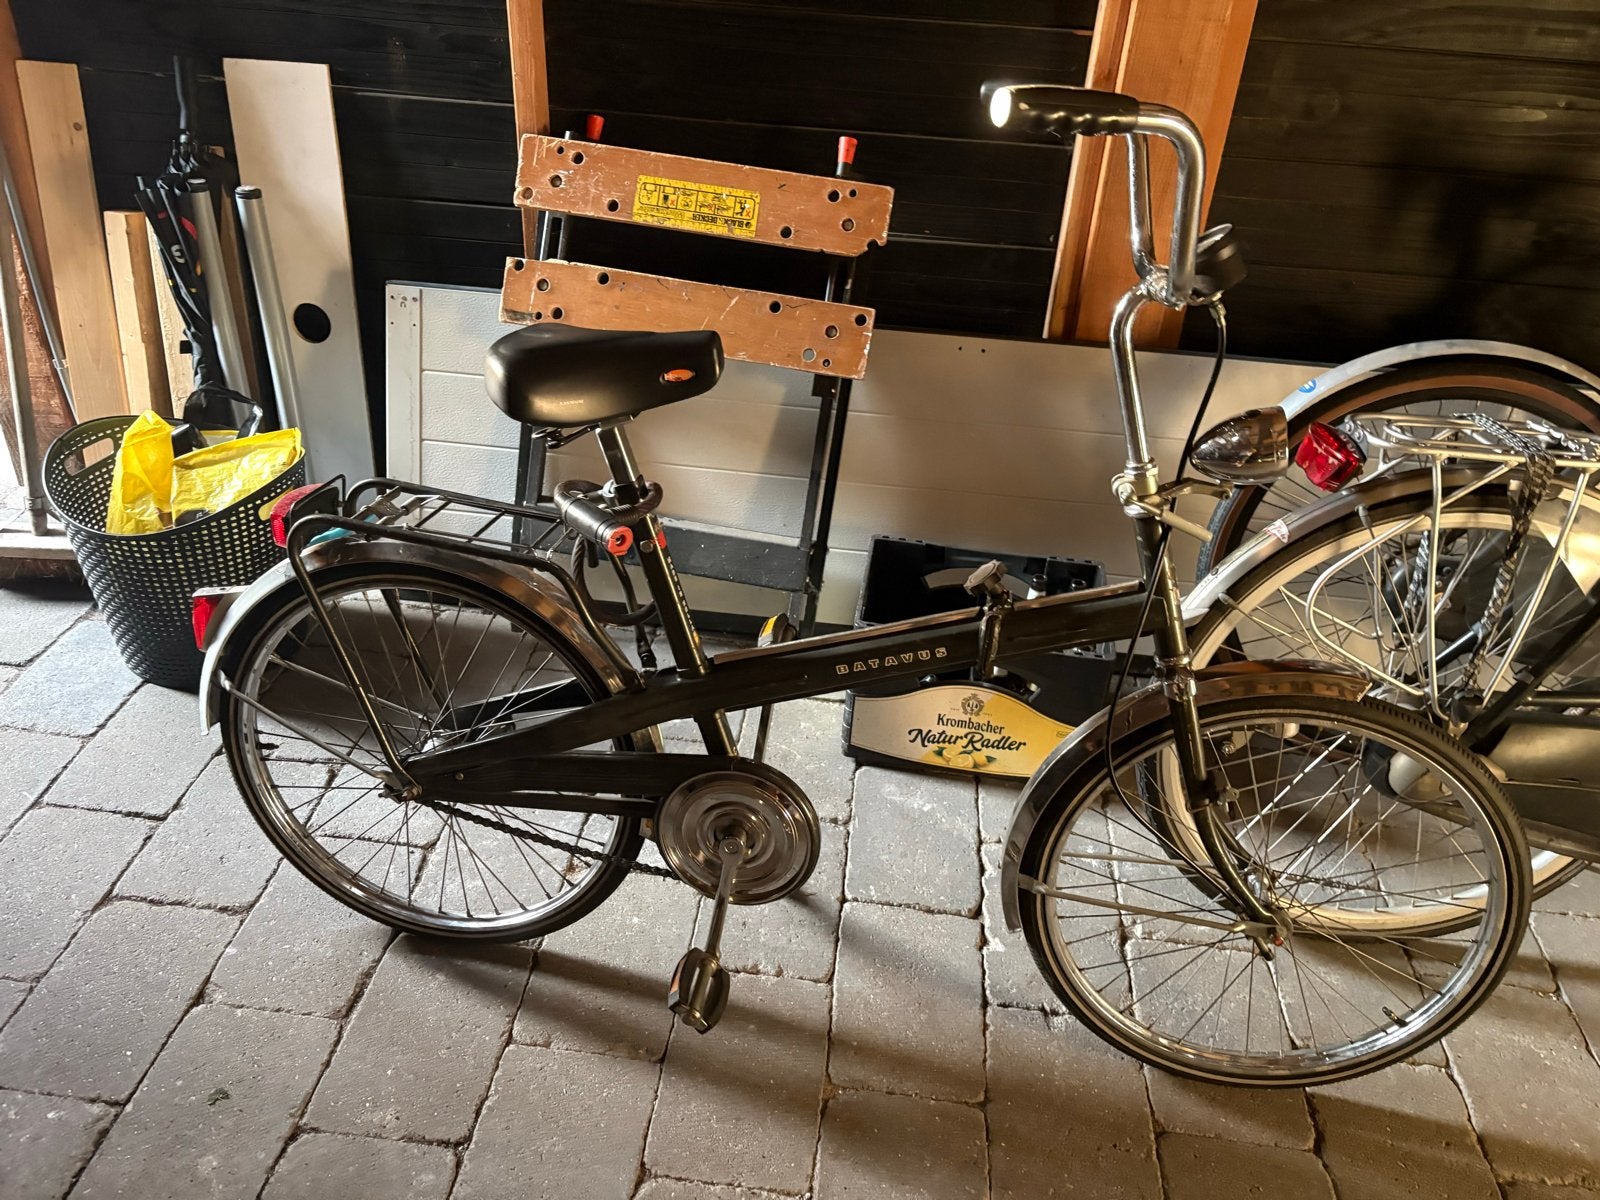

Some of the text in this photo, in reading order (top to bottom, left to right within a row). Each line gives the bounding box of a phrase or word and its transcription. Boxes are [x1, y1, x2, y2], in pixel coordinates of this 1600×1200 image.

[693, 213, 717, 224] DECKER
[836, 647, 947, 675] BATAVUS
[936, 713, 1005, 735] Krombacher
[908, 728, 1027, 752] Natur Radler
